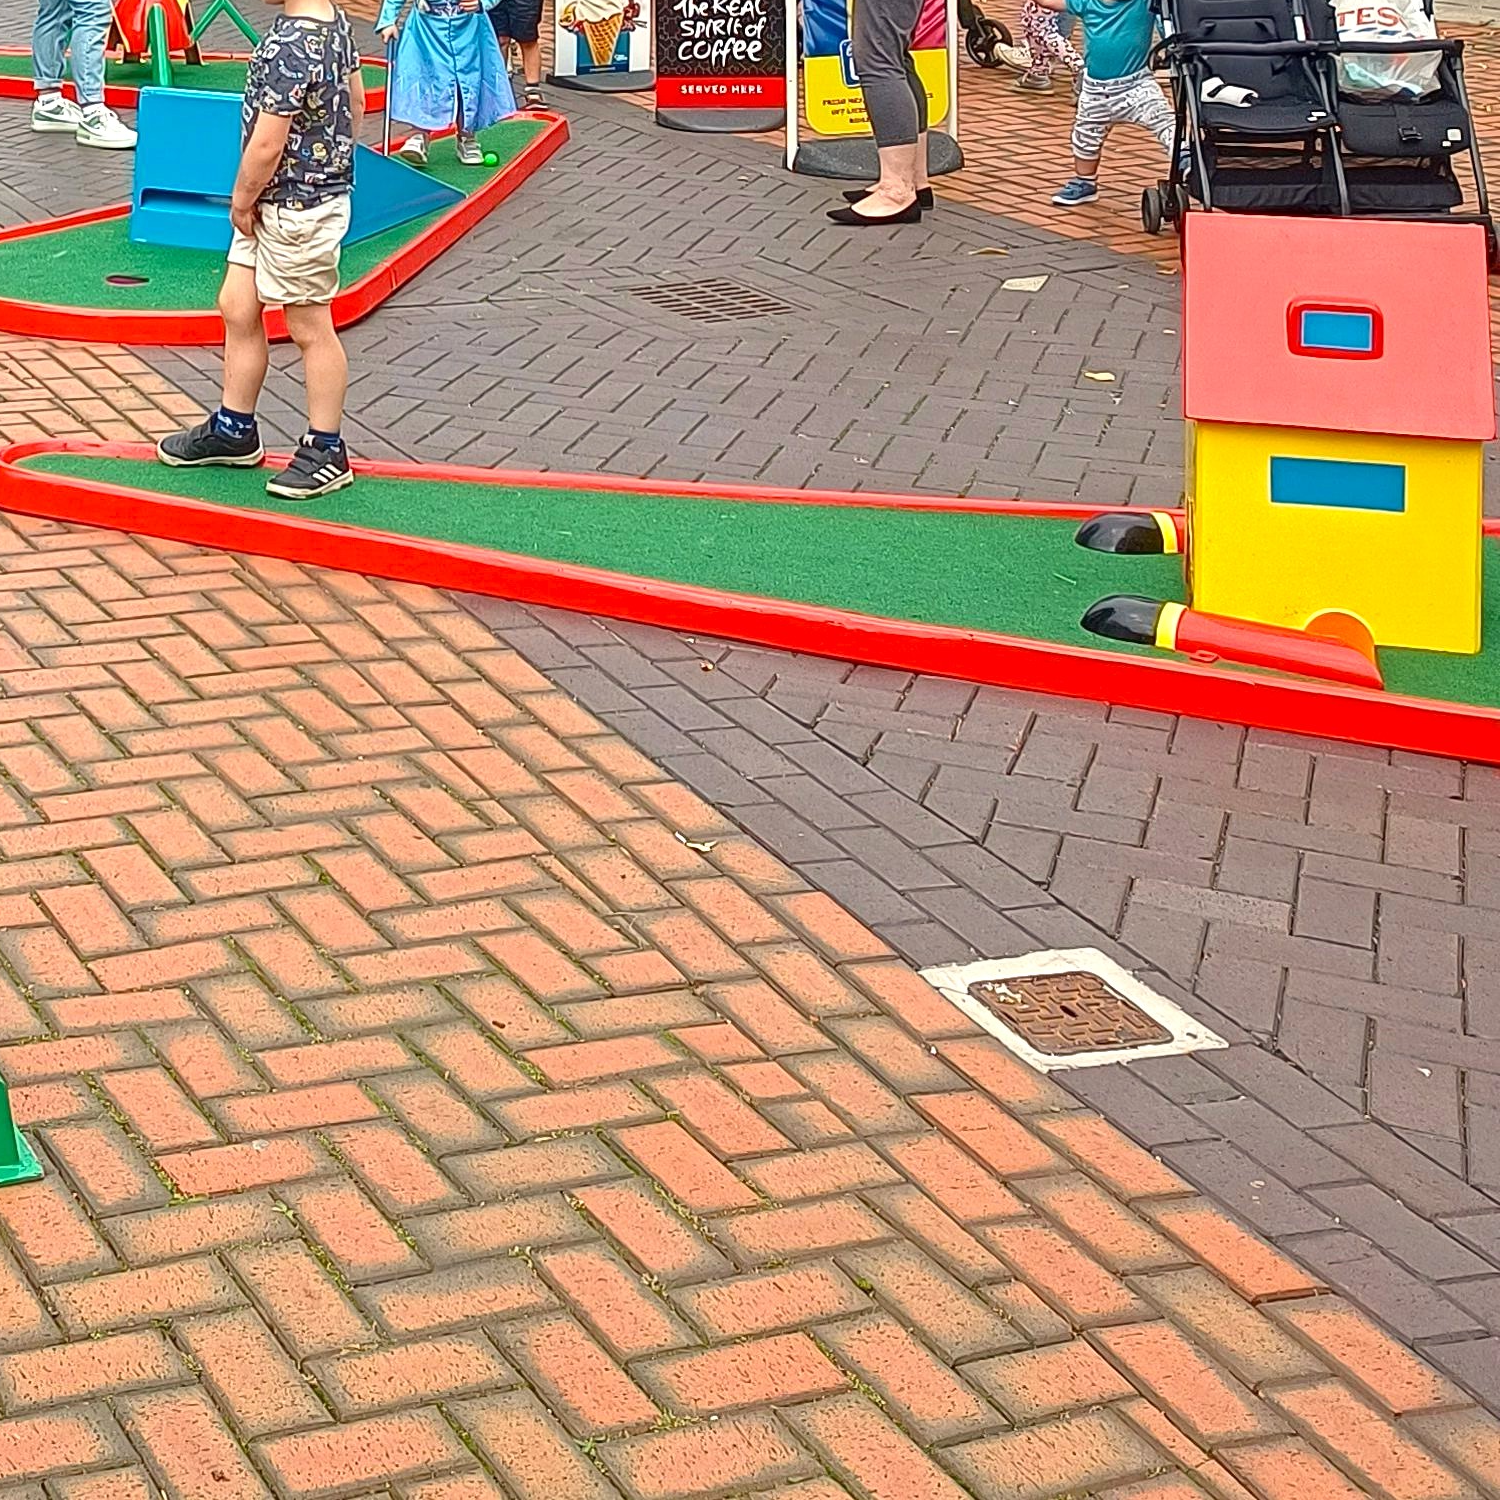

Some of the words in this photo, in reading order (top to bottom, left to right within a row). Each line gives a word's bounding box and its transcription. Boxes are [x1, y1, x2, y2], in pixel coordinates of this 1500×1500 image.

[745, 16, 767, 40] of
[1337, 6, 1400, 28] TES
[680, 84, 727, 94] SERVED
[731, 84, 764, 94] HERE
